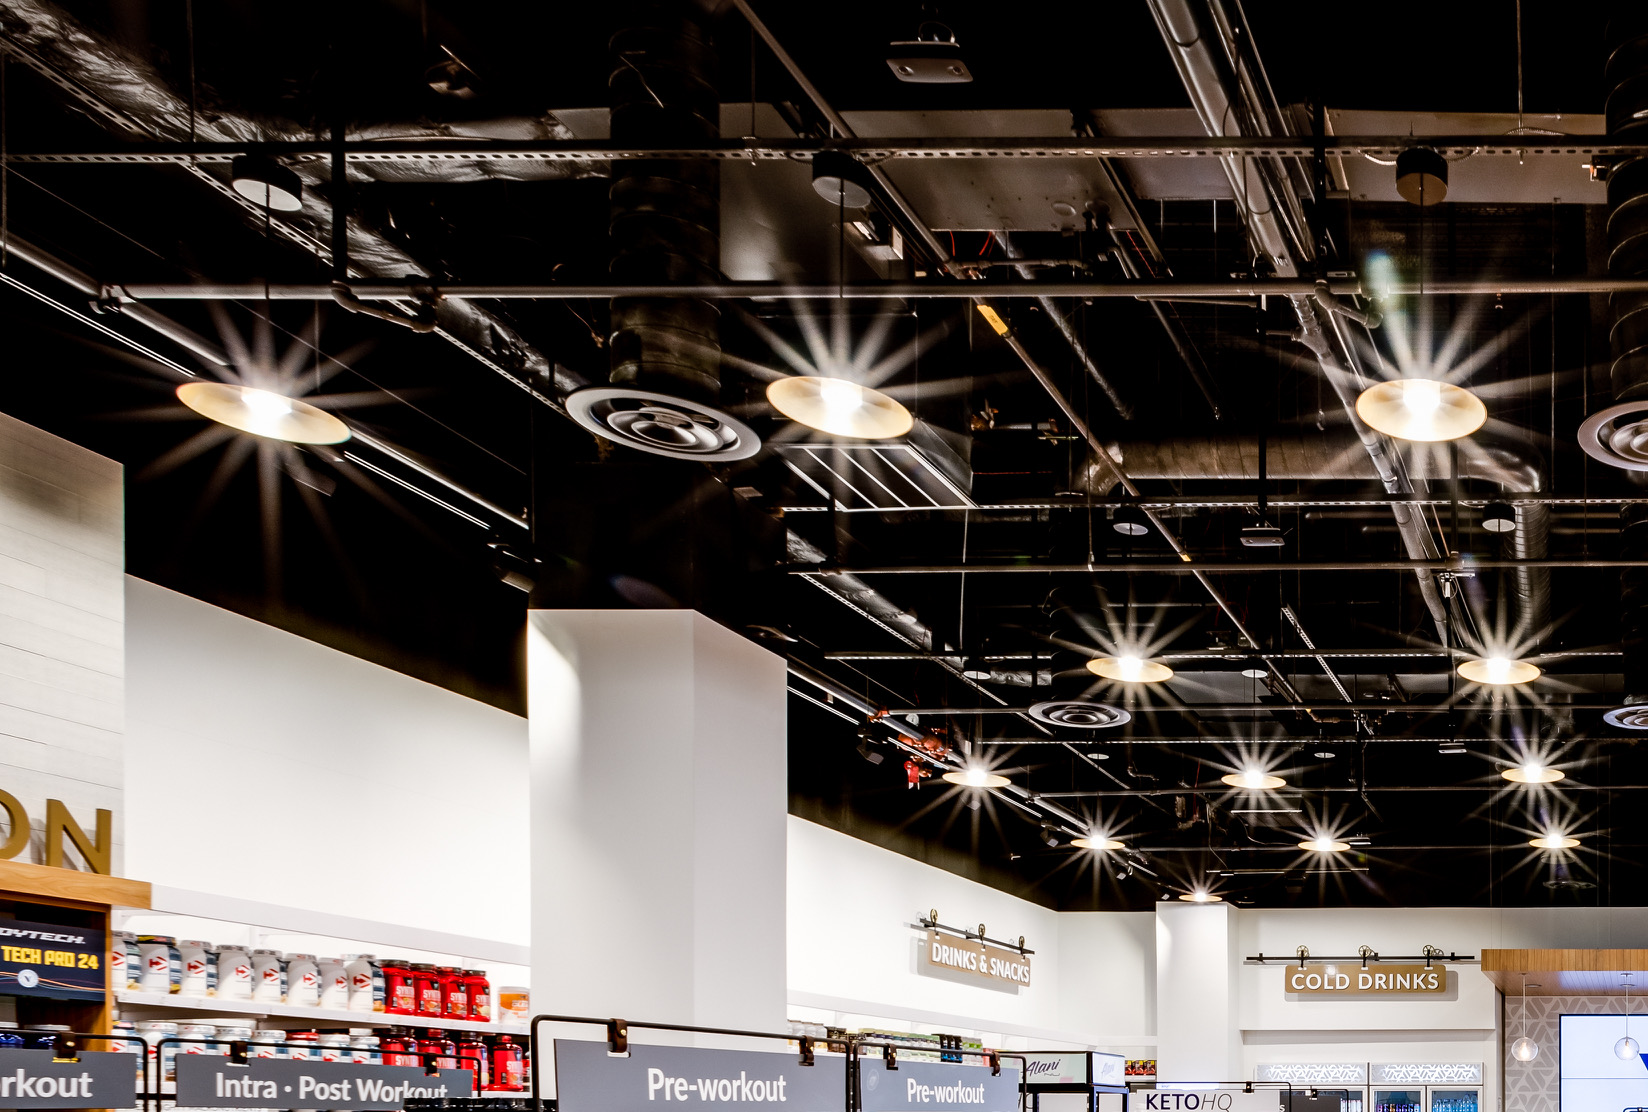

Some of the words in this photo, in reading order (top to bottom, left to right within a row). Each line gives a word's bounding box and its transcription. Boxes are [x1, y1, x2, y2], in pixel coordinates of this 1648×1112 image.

[1, 946, 41, 963] TECH
[45, 950, 76, 967] PRO
[78, 954, 99, 970] 24
[932, 942, 976, 971] DRINKS
[979, 956, 988, 972] &
[990, 958, 1030, 983] SNACKS
[1291, 973, 1350, 990] COLD
[1358, 973, 1439, 990] DRINKS
[1, 1069, 93, 1098] rkout
[216, 1073, 277, 1098] Intra
[299, 1076, 351, 1101] Post
[356, 1078, 448, 1102] Workout
[648, 1068, 787, 1103] Pre-workout
[906, 1078, 984, 1104] Pre-workout
